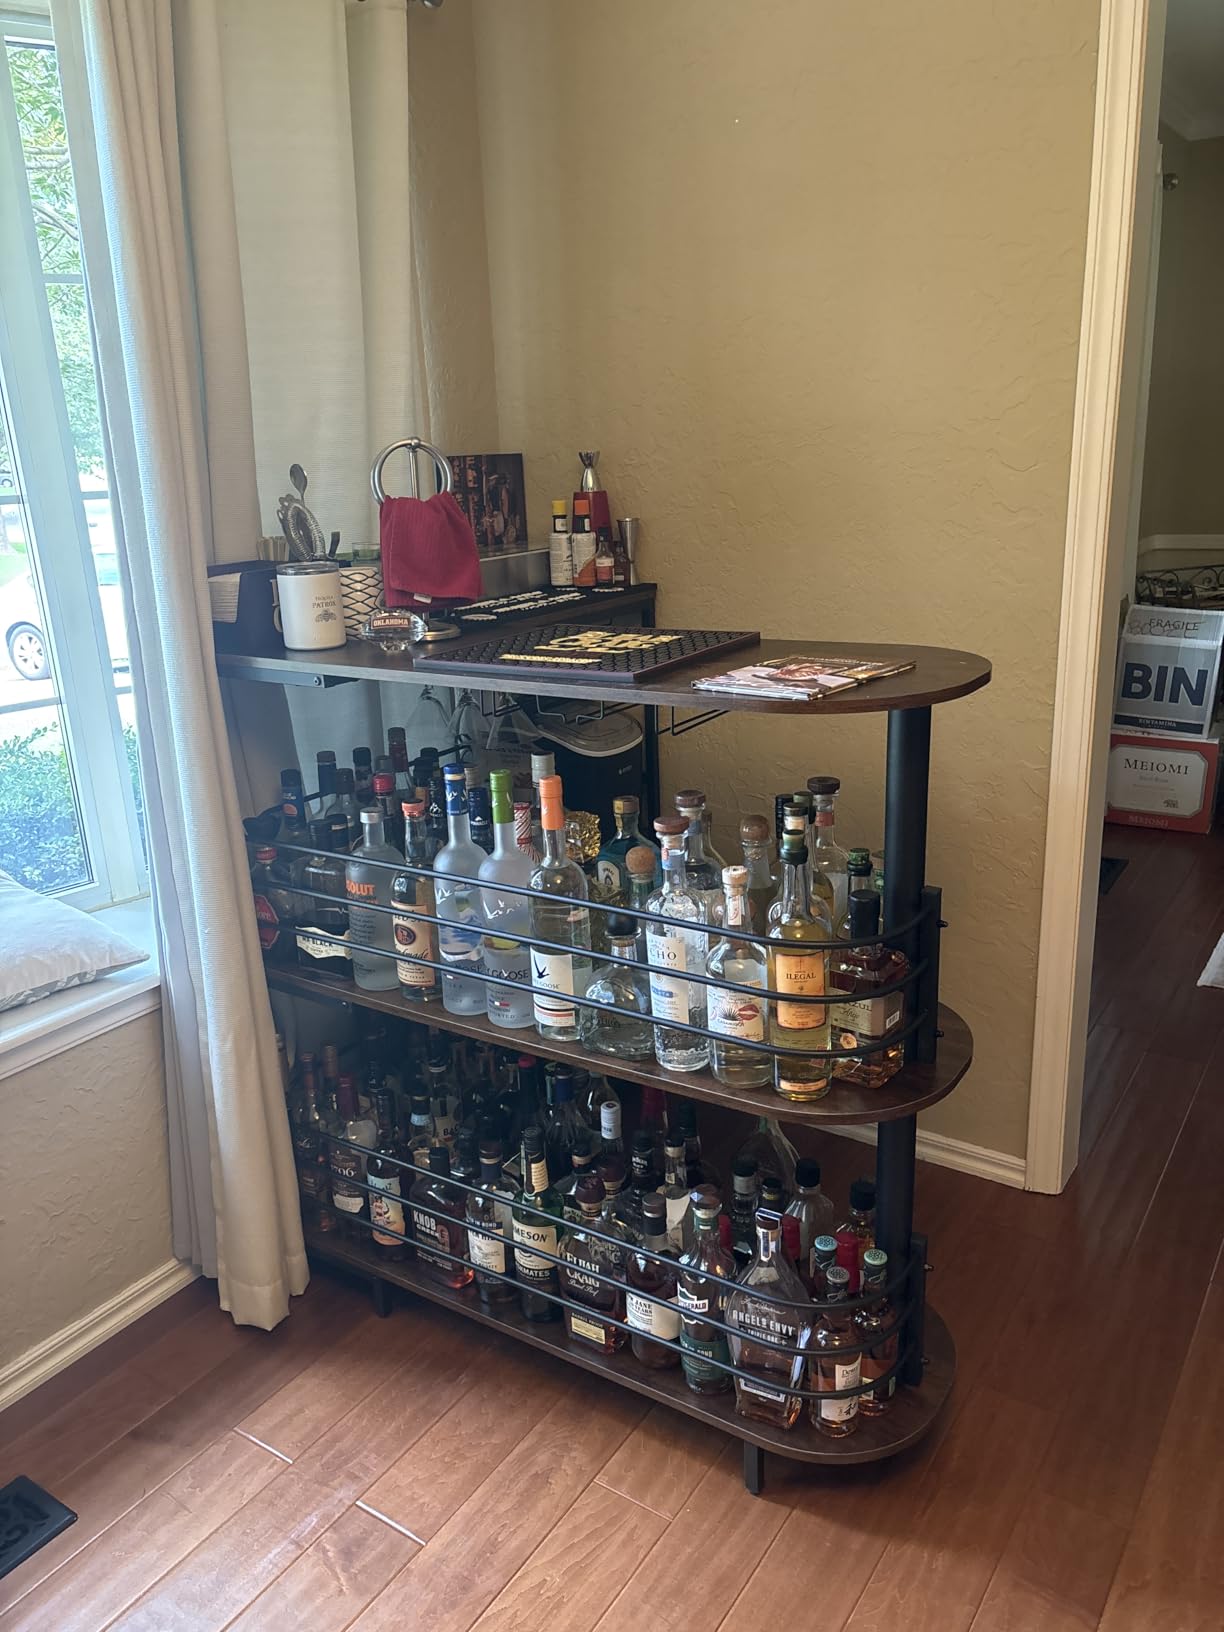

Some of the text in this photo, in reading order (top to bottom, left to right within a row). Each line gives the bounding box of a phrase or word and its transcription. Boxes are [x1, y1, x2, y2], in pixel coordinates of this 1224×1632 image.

[373, 618, 408, 628] OKLAHOMA
[1149, 618, 1203, 632] FRAGILE
[1121, 662, 1209, 707] BIN
[1124, 758, 1189, 775] MEIOMI
[786, 972, 816, 980] ILEGAL
[413, 1210, 436, 1231] KNOB
[514, 1226, 548, 1243] MESON
[769, 1320, 793, 1336] ENVY
